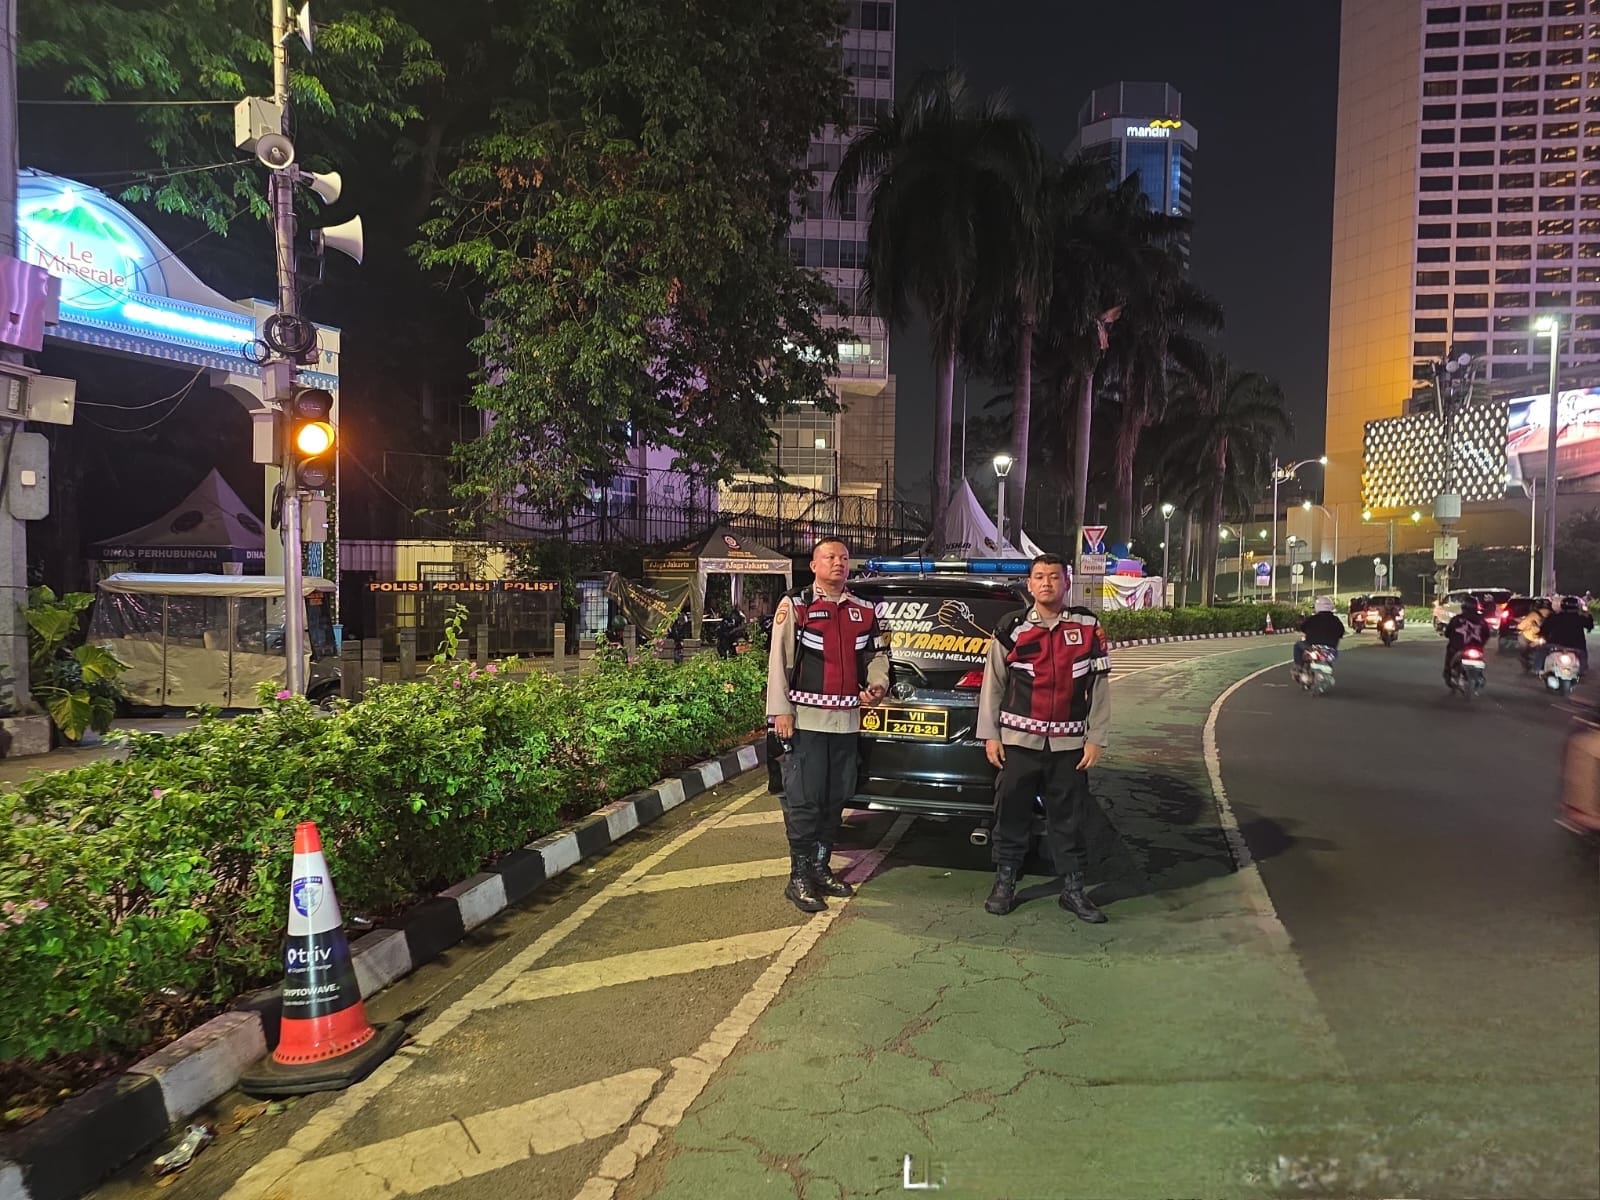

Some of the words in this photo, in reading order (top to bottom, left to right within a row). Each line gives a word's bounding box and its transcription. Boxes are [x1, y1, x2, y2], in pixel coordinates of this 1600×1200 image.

[1126, 125, 1170, 138] mandiri
[69, 241, 93, 264] Le
[38, 250, 126, 288] Minerale
[138, 549, 218, 559] PERHUBUNGAN
[667, 560, 690, 568] Jakarta
[744, 561, 769, 570] Jakarta
[370, 582, 424, 592] POLISI
[437, 582, 491, 592] POLISI
[504, 582, 554, 592] POLISI
[874, 602, 930, 620] OLISI
[879, 622, 933, 633] ERSAMA
[882, 632, 992, 655] ASYARAKAT
[923, 651, 944, 660] DAN
[945, 653, 988, 664] MELAYAN
[908, 711, 925, 722] VII
[892, 723, 939, 735] 2478-28
